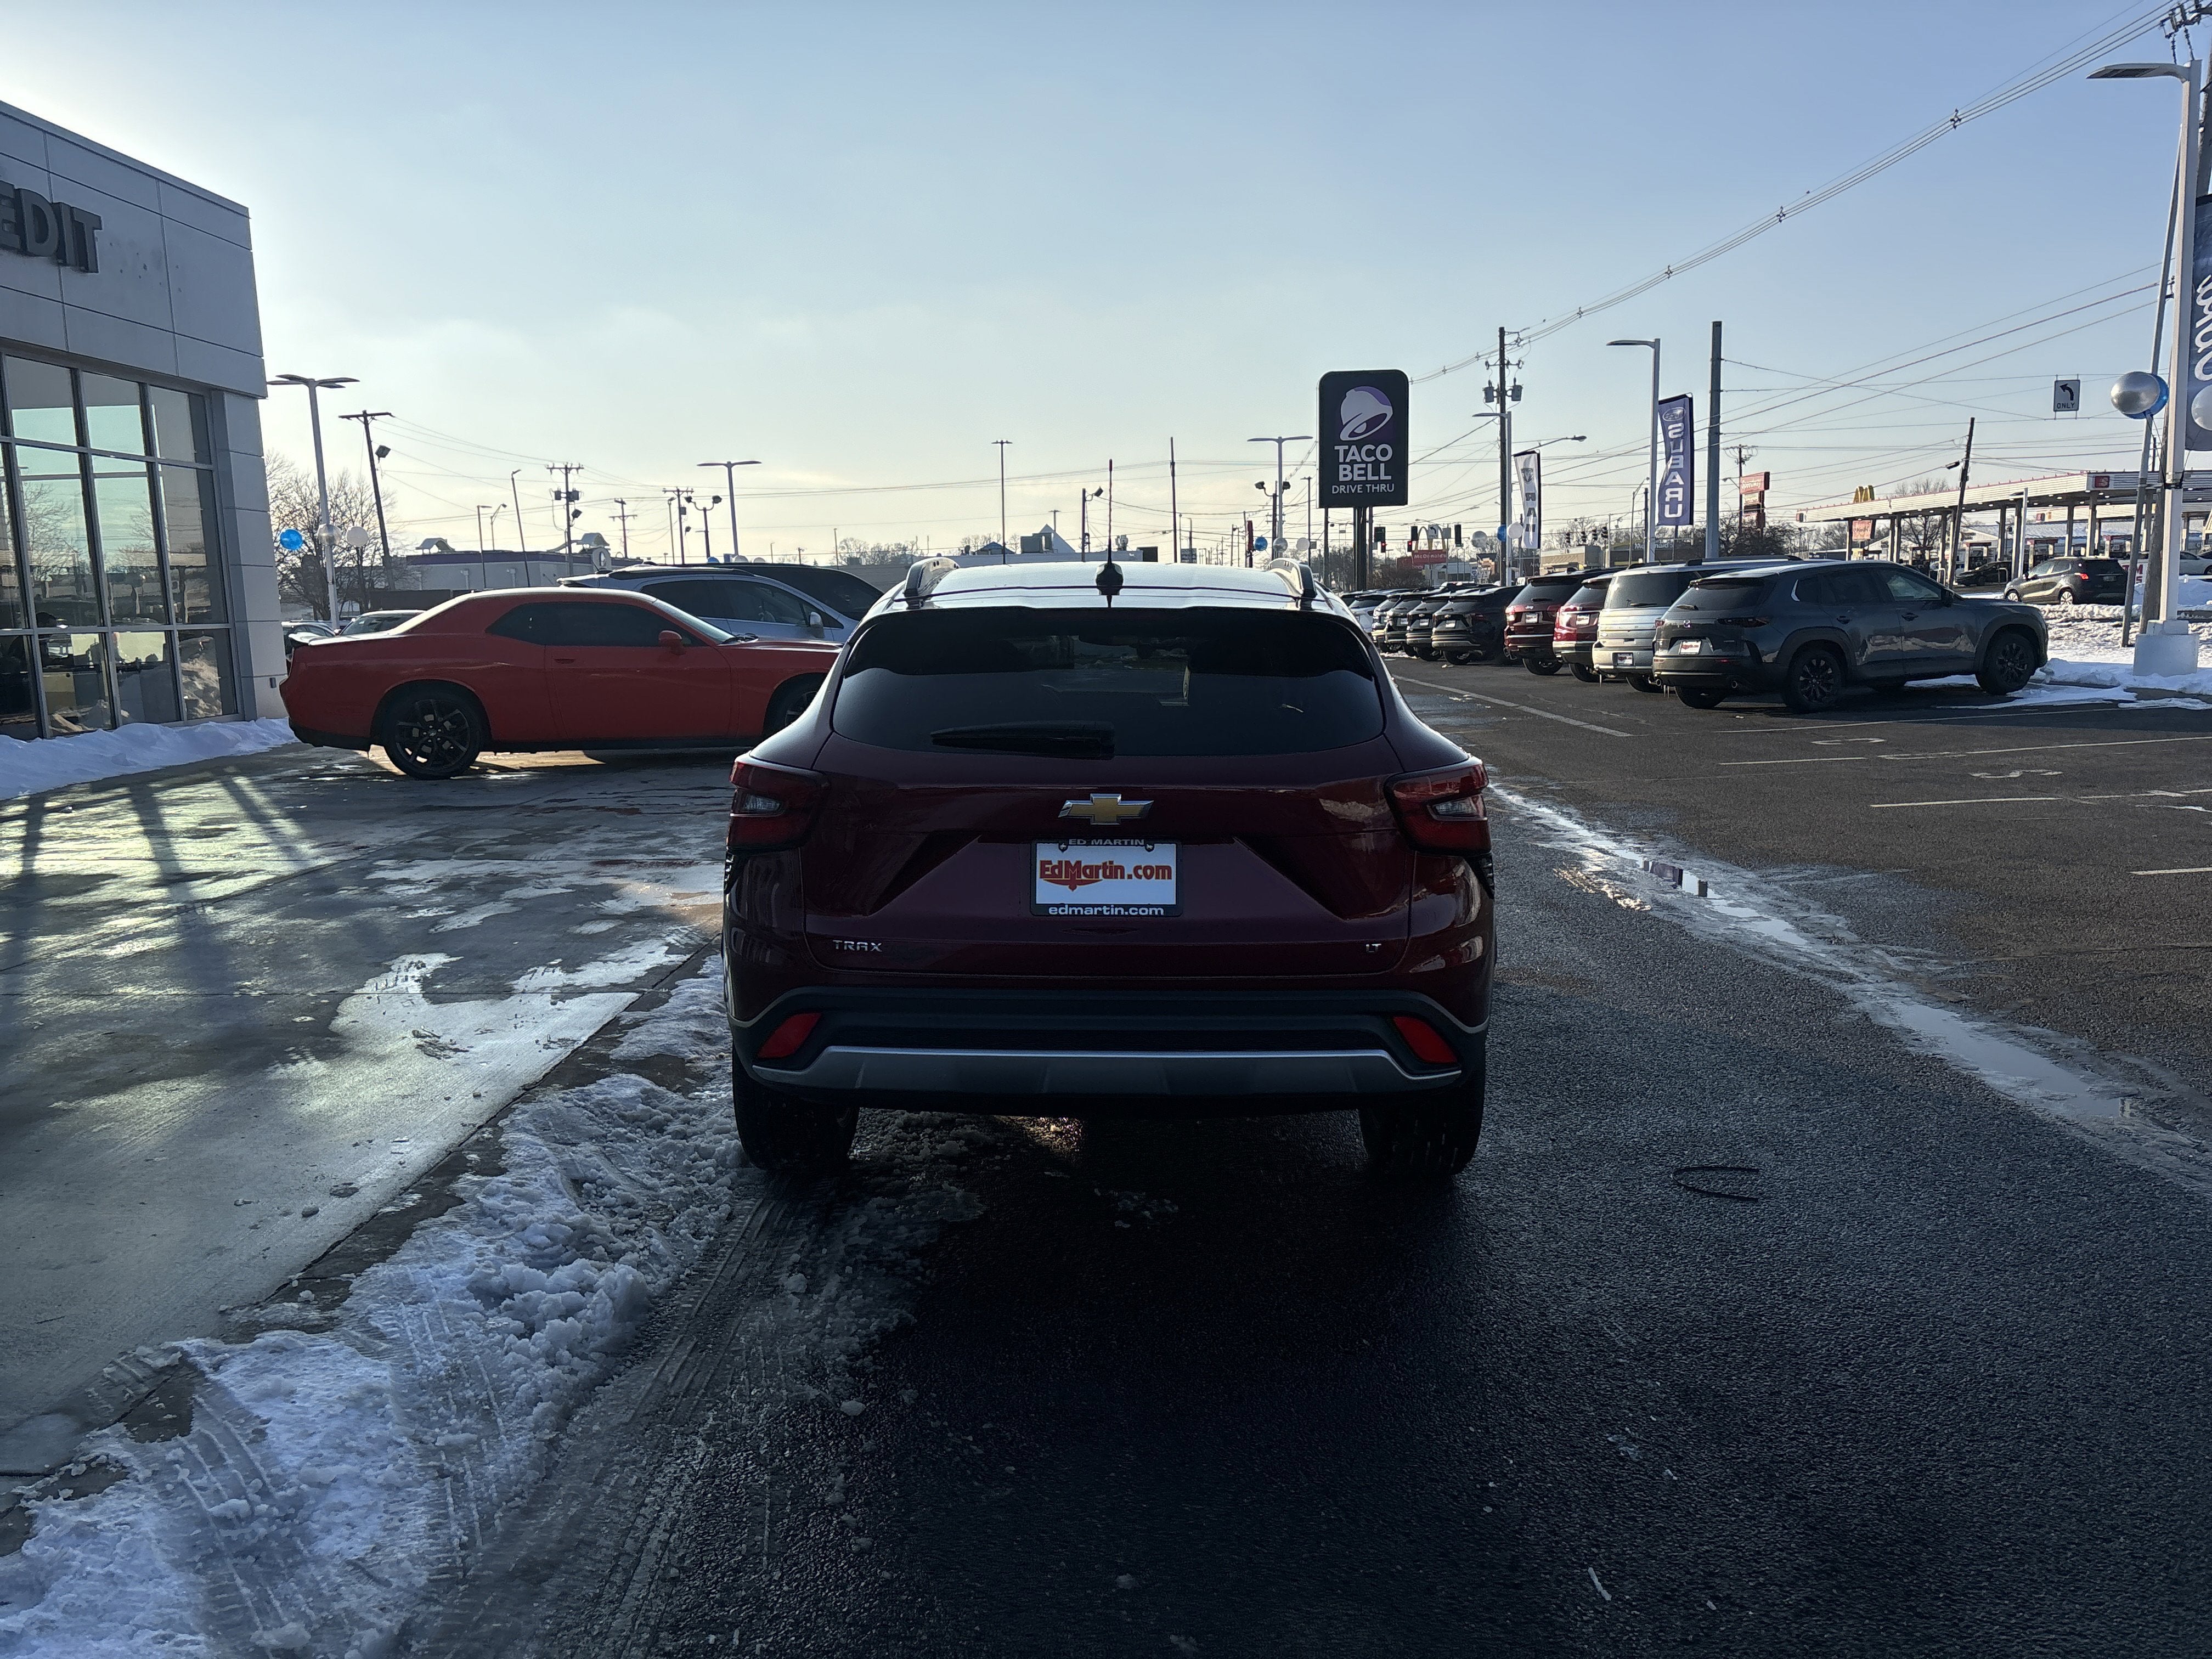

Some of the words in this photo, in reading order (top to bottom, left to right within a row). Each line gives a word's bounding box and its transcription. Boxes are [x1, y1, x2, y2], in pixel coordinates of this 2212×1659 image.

[1334, 443, 1393, 463] TACO
[1338, 463, 1392, 482] BELL
[1331, 484, 1363, 494] DRIVE
[1365, 483, 1395, 493] THRU
[1039, 859, 1173, 882] EdMartin.com
[1048, 904, 1164, 916] edmartin.com
[832, 939, 883, 952] TRAX
[1365, 943, 1382, 953] LT
